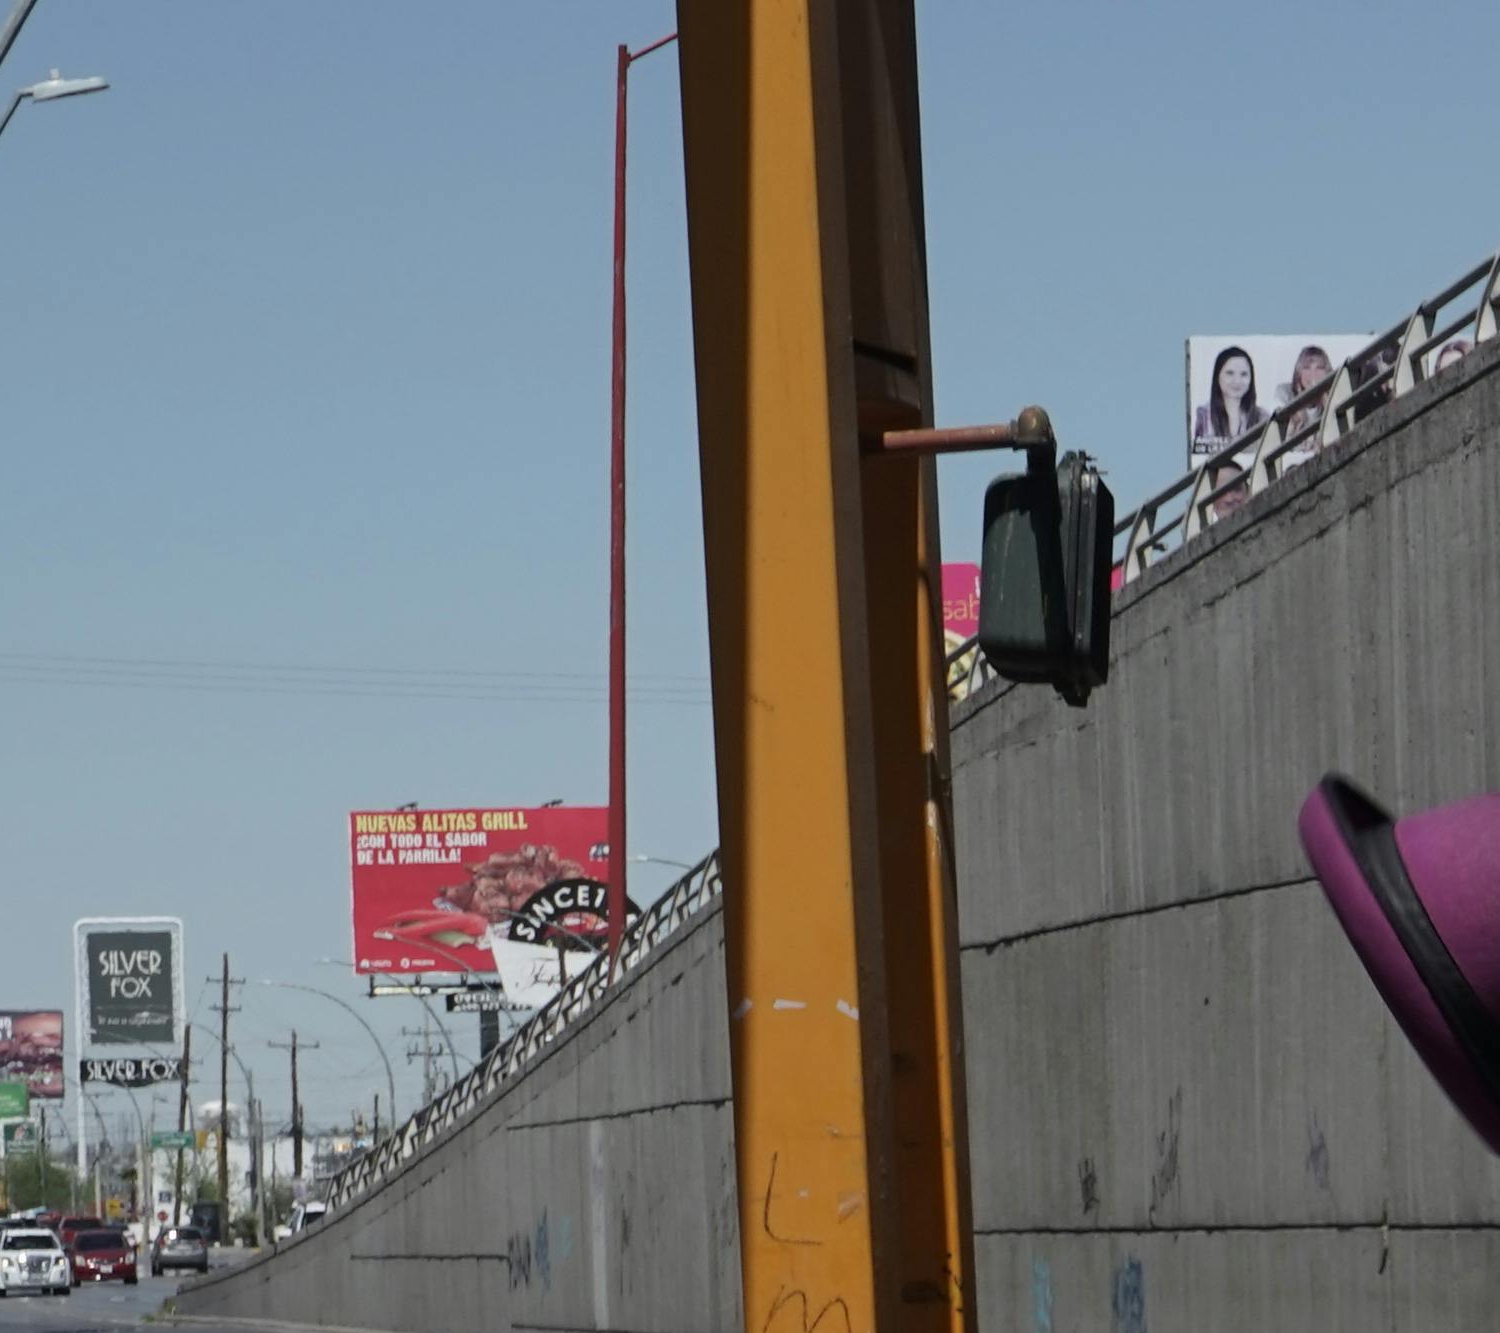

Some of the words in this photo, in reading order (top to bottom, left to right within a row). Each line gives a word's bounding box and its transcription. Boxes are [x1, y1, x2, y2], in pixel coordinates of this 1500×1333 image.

[356, 814, 416, 833] NUEVAS
[422, 812, 477, 832] ALITAS
[482, 811, 528, 830] GRILL
[390, 833, 423, 848] TODO
[426, 832, 442, 848] EL
[445, 832, 487, 847] SABOR
[357, 849, 374, 865] DE
[378, 849, 395, 864] LA
[399, 848, 462, 864] PARRILLA!
[516, 885, 590, 941] SINCE
[99, 950, 161, 976] SILVER
[110, 976, 152, 998] FOX
[87, 1060, 135, 1080] SILVER
[141, 1060, 179, 1080] FOX
